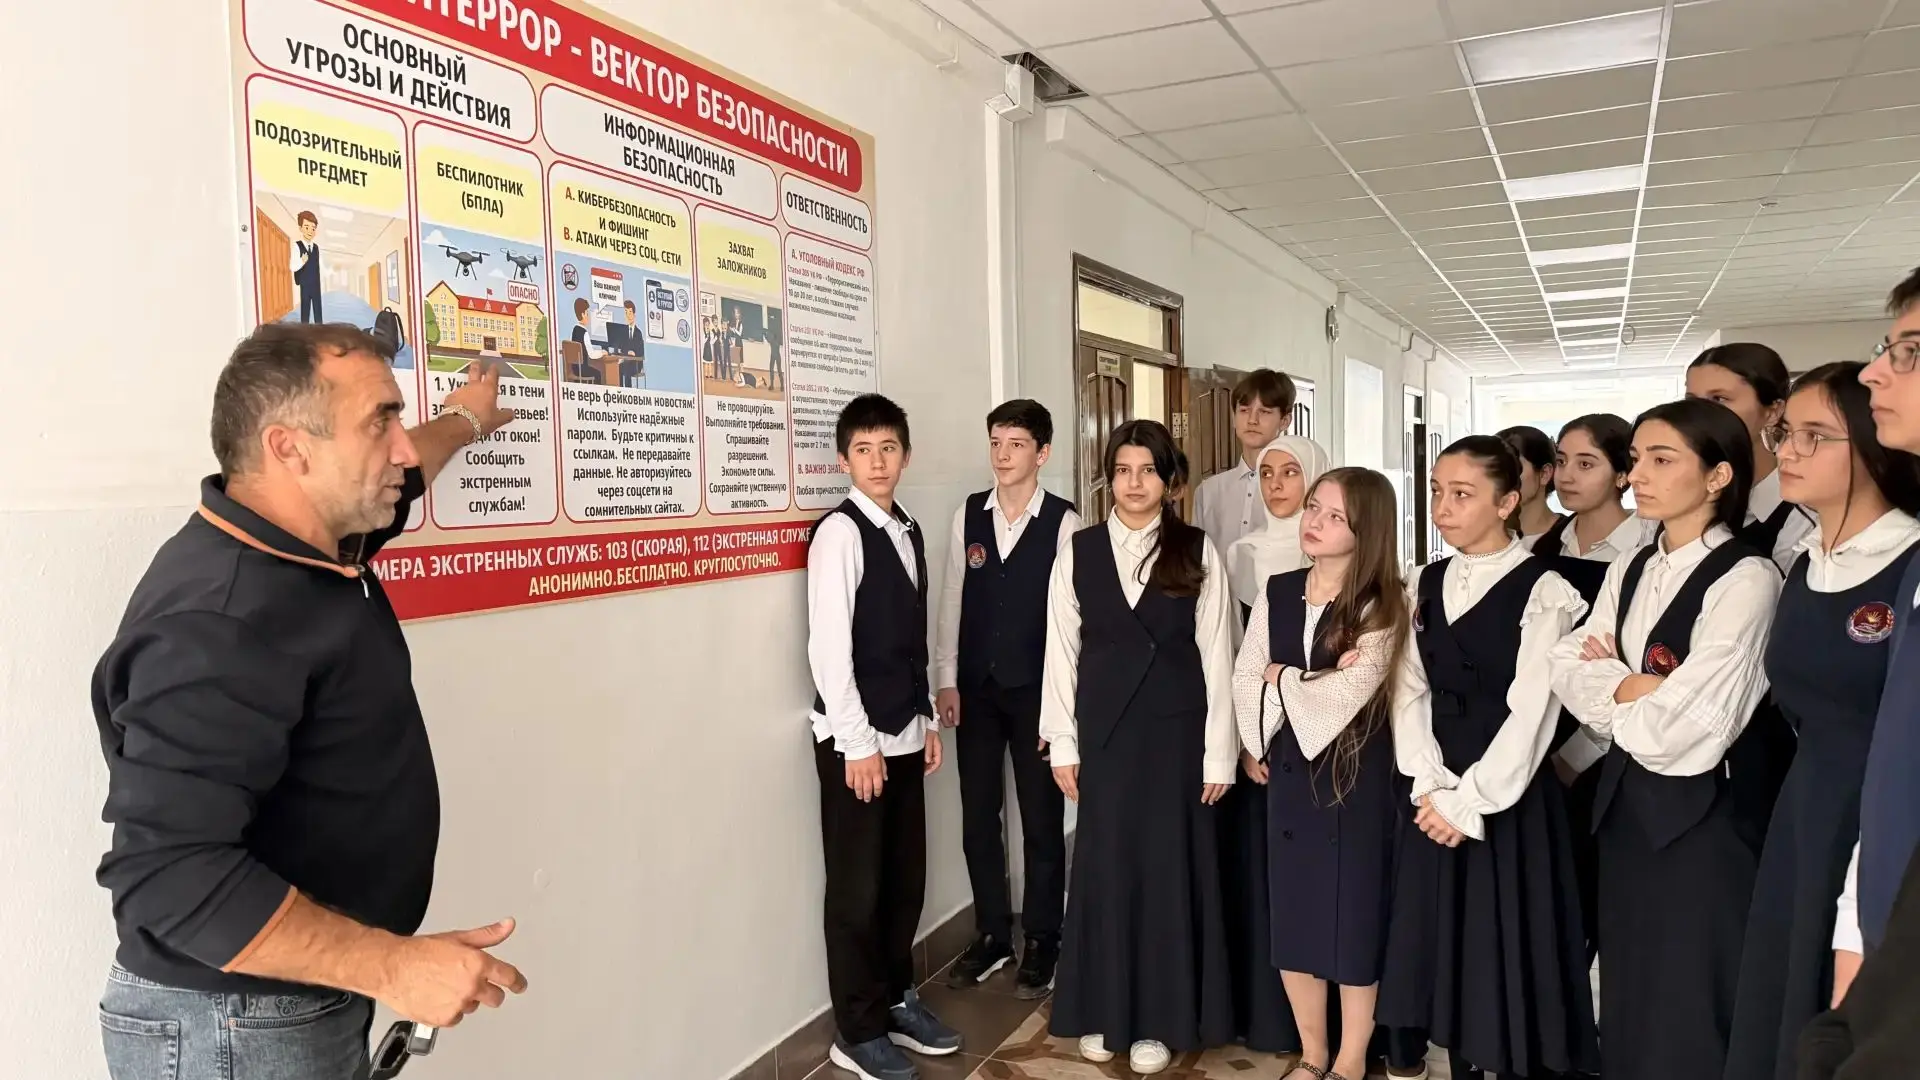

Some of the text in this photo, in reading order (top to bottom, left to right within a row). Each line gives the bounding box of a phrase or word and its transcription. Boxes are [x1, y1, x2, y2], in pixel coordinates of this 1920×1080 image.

[343, 23, 466, 85] ОСНОВНЫЙ
[286, 38, 511, 130] УГРОЗЫ И ДЕЙСТВИЯ
[571, 44, 581, 55] -
[591, 36, 689, 109] ВЕКТОР
[697, 82, 848, 177] БЕЗОПАСНОСТИ
[255, 119, 402, 170] ПОДОЗРИТЕЛЬНЫЙ
[604, 112, 735, 177] ИНФОРМАЦИОННАЯ
[298, 157, 367, 187] ПРЕДМЕТ
[437, 162, 524, 197] БЕСПИЛОТНИК
[623, 146, 722, 196] БЕЗОПАСНОСТЬ
[462, 191, 503, 218] (БПЛА)
[565, 186, 676, 228] А. КИБЕРБЕЗОПАСНОСТЬ
[786, 191, 868, 233] ОТВЕТСТВЕННОСТЬ
[599, 217, 649, 241] И ФИШИНГ
[576, 230, 607, 249] АТАКИ
[609, 239, 637, 256] ЧЕРЕЗ
[639, 245, 660, 263] СОЦ.
[661, 250, 681, 266] СЕТИ
[728, 241, 755, 259] ЗАХВАТ
[717, 256, 767, 280] ЗАЛОЖНИКОВ
[799, 250, 835, 270] УГОЛОВНЫЙ
[835, 260, 856, 277] КОДЕКС
[857, 267, 865, 278] РФ
[509, 285, 538, 301] ОПАСНО
[510, 385, 516, 396] в
[519, 385, 545, 398] тени
[562, 387, 695, 410] Не верь фейковым новостям!
[514, 406, 549, 421] евьев!
[577, 408, 685, 427] Используйте надёжные
[717, 401, 775, 416] Не провоцируйте.
[705, 416, 786, 432] Выполняйте требования.
[494, 430, 507, 442] от
[510, 428, 541, 443] окон!
[567, 429, 695, 446] пароли. Будьте критичны к
[725, 433, 770, 447] Спрашивайте
[465, 450, 525, 468] Сообщить
[573, 447, 691, 463] ссылкам. Не передавайте
[727, 451, 769, 463] разрешения.
[573, 465, 692, 481] данные. Не авторизуйтесь
[721, 466, 776, 477] Экономьте силы.
[805, 464, 827, 474] ВАЖНО
[460, 477, 532, 493] экстренным
[597, 485, 673, 501] через соцсети на
[709, 481, 787, 496] Сохраняйте умственную
[796, 485, 815, 496] Любая
[469, 496, 526, 516] службам!
[584, 500, 685, 517] сомнительных сайтах.
[731, 499, 769, 509] активность.
[368, 557, 426, 581] МЕРА
[430, 547, 543, 577] ЭКСТРЕННЫХ
[546, 543, 603, 567] СЛУЖБ:
[605, 541, 627, 561] 103
[631, 535, 691, 562] (СКОРАЯ),
[693, 534, 710, 552] 112
[712, 528, 779, 554] (ЭКСТРЕННАЯ
[694, 551, 782, 576] КРУГЛОСУТОЧНО.
